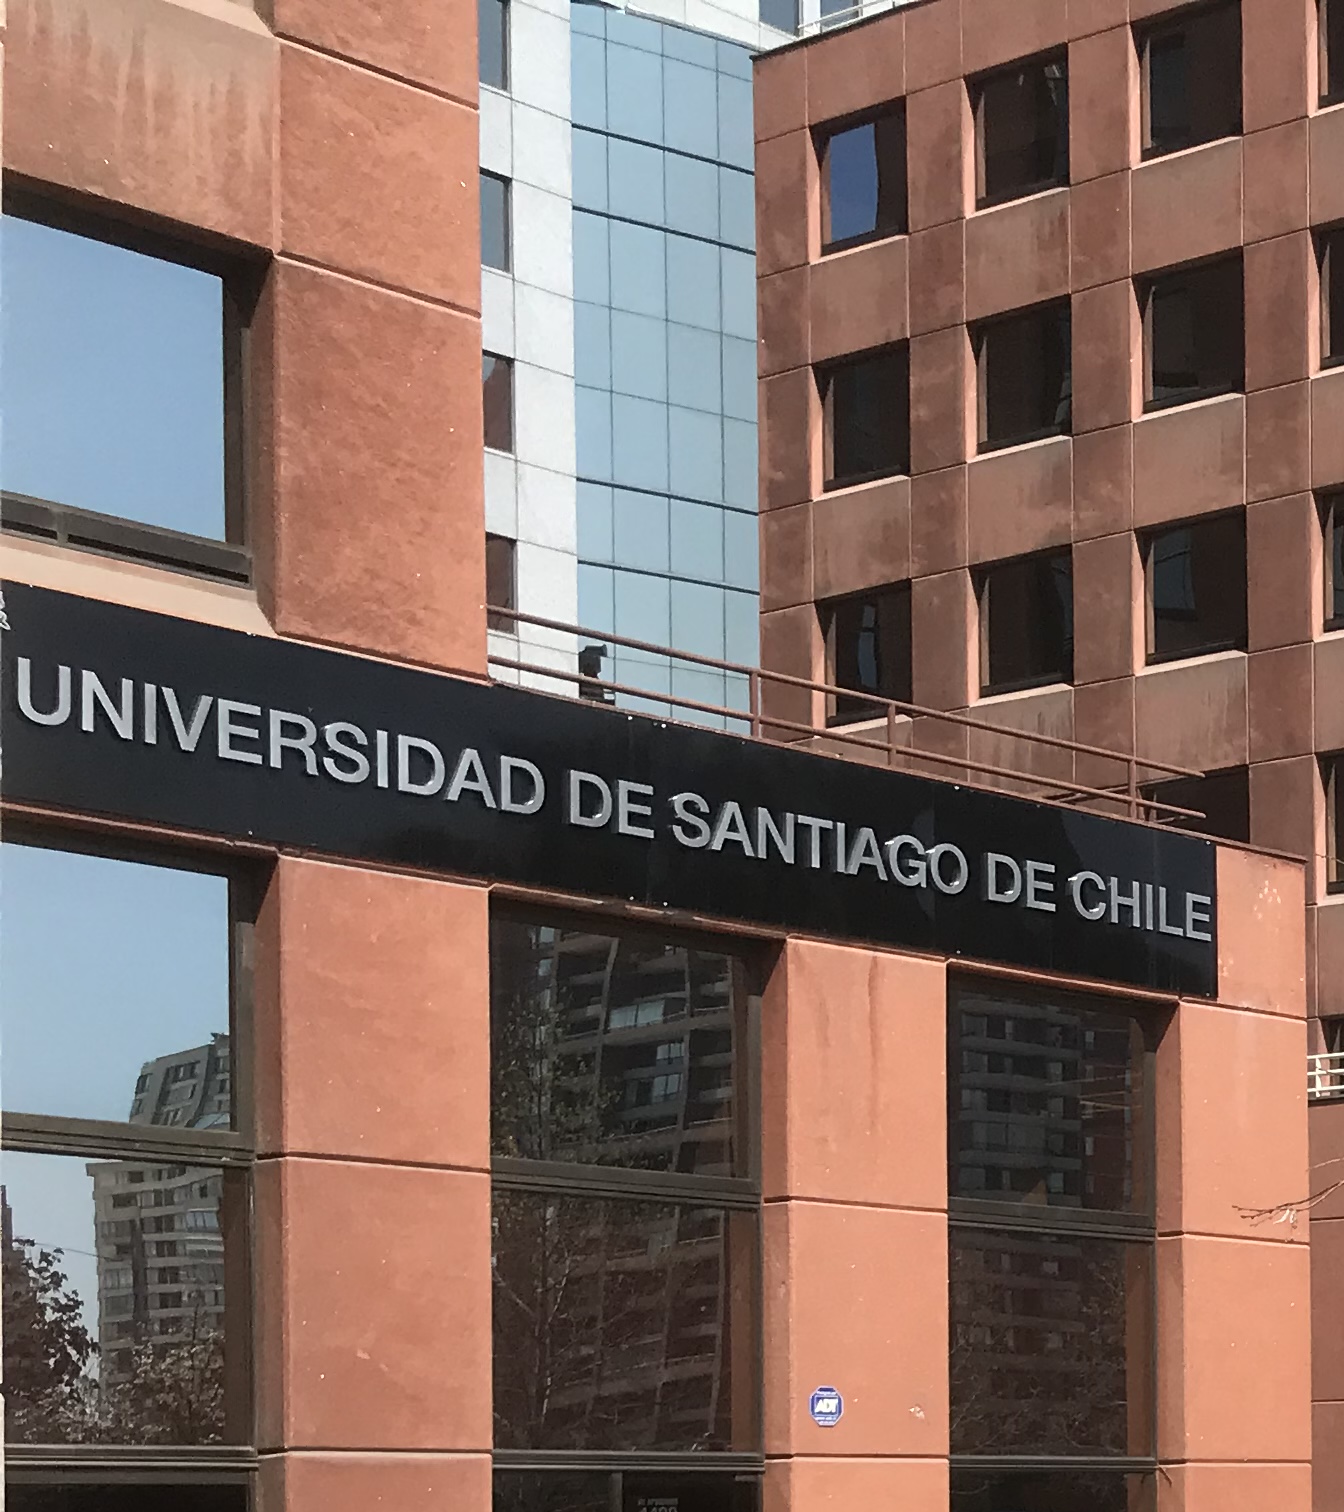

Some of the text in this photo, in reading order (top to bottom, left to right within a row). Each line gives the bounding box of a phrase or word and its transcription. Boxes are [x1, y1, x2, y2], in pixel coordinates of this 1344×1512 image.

[17, 656, 1213, 942] UNIVERSIDAD DE SANTIAGO DE CHILE
[814, 1398, 839, 1413] ADT
